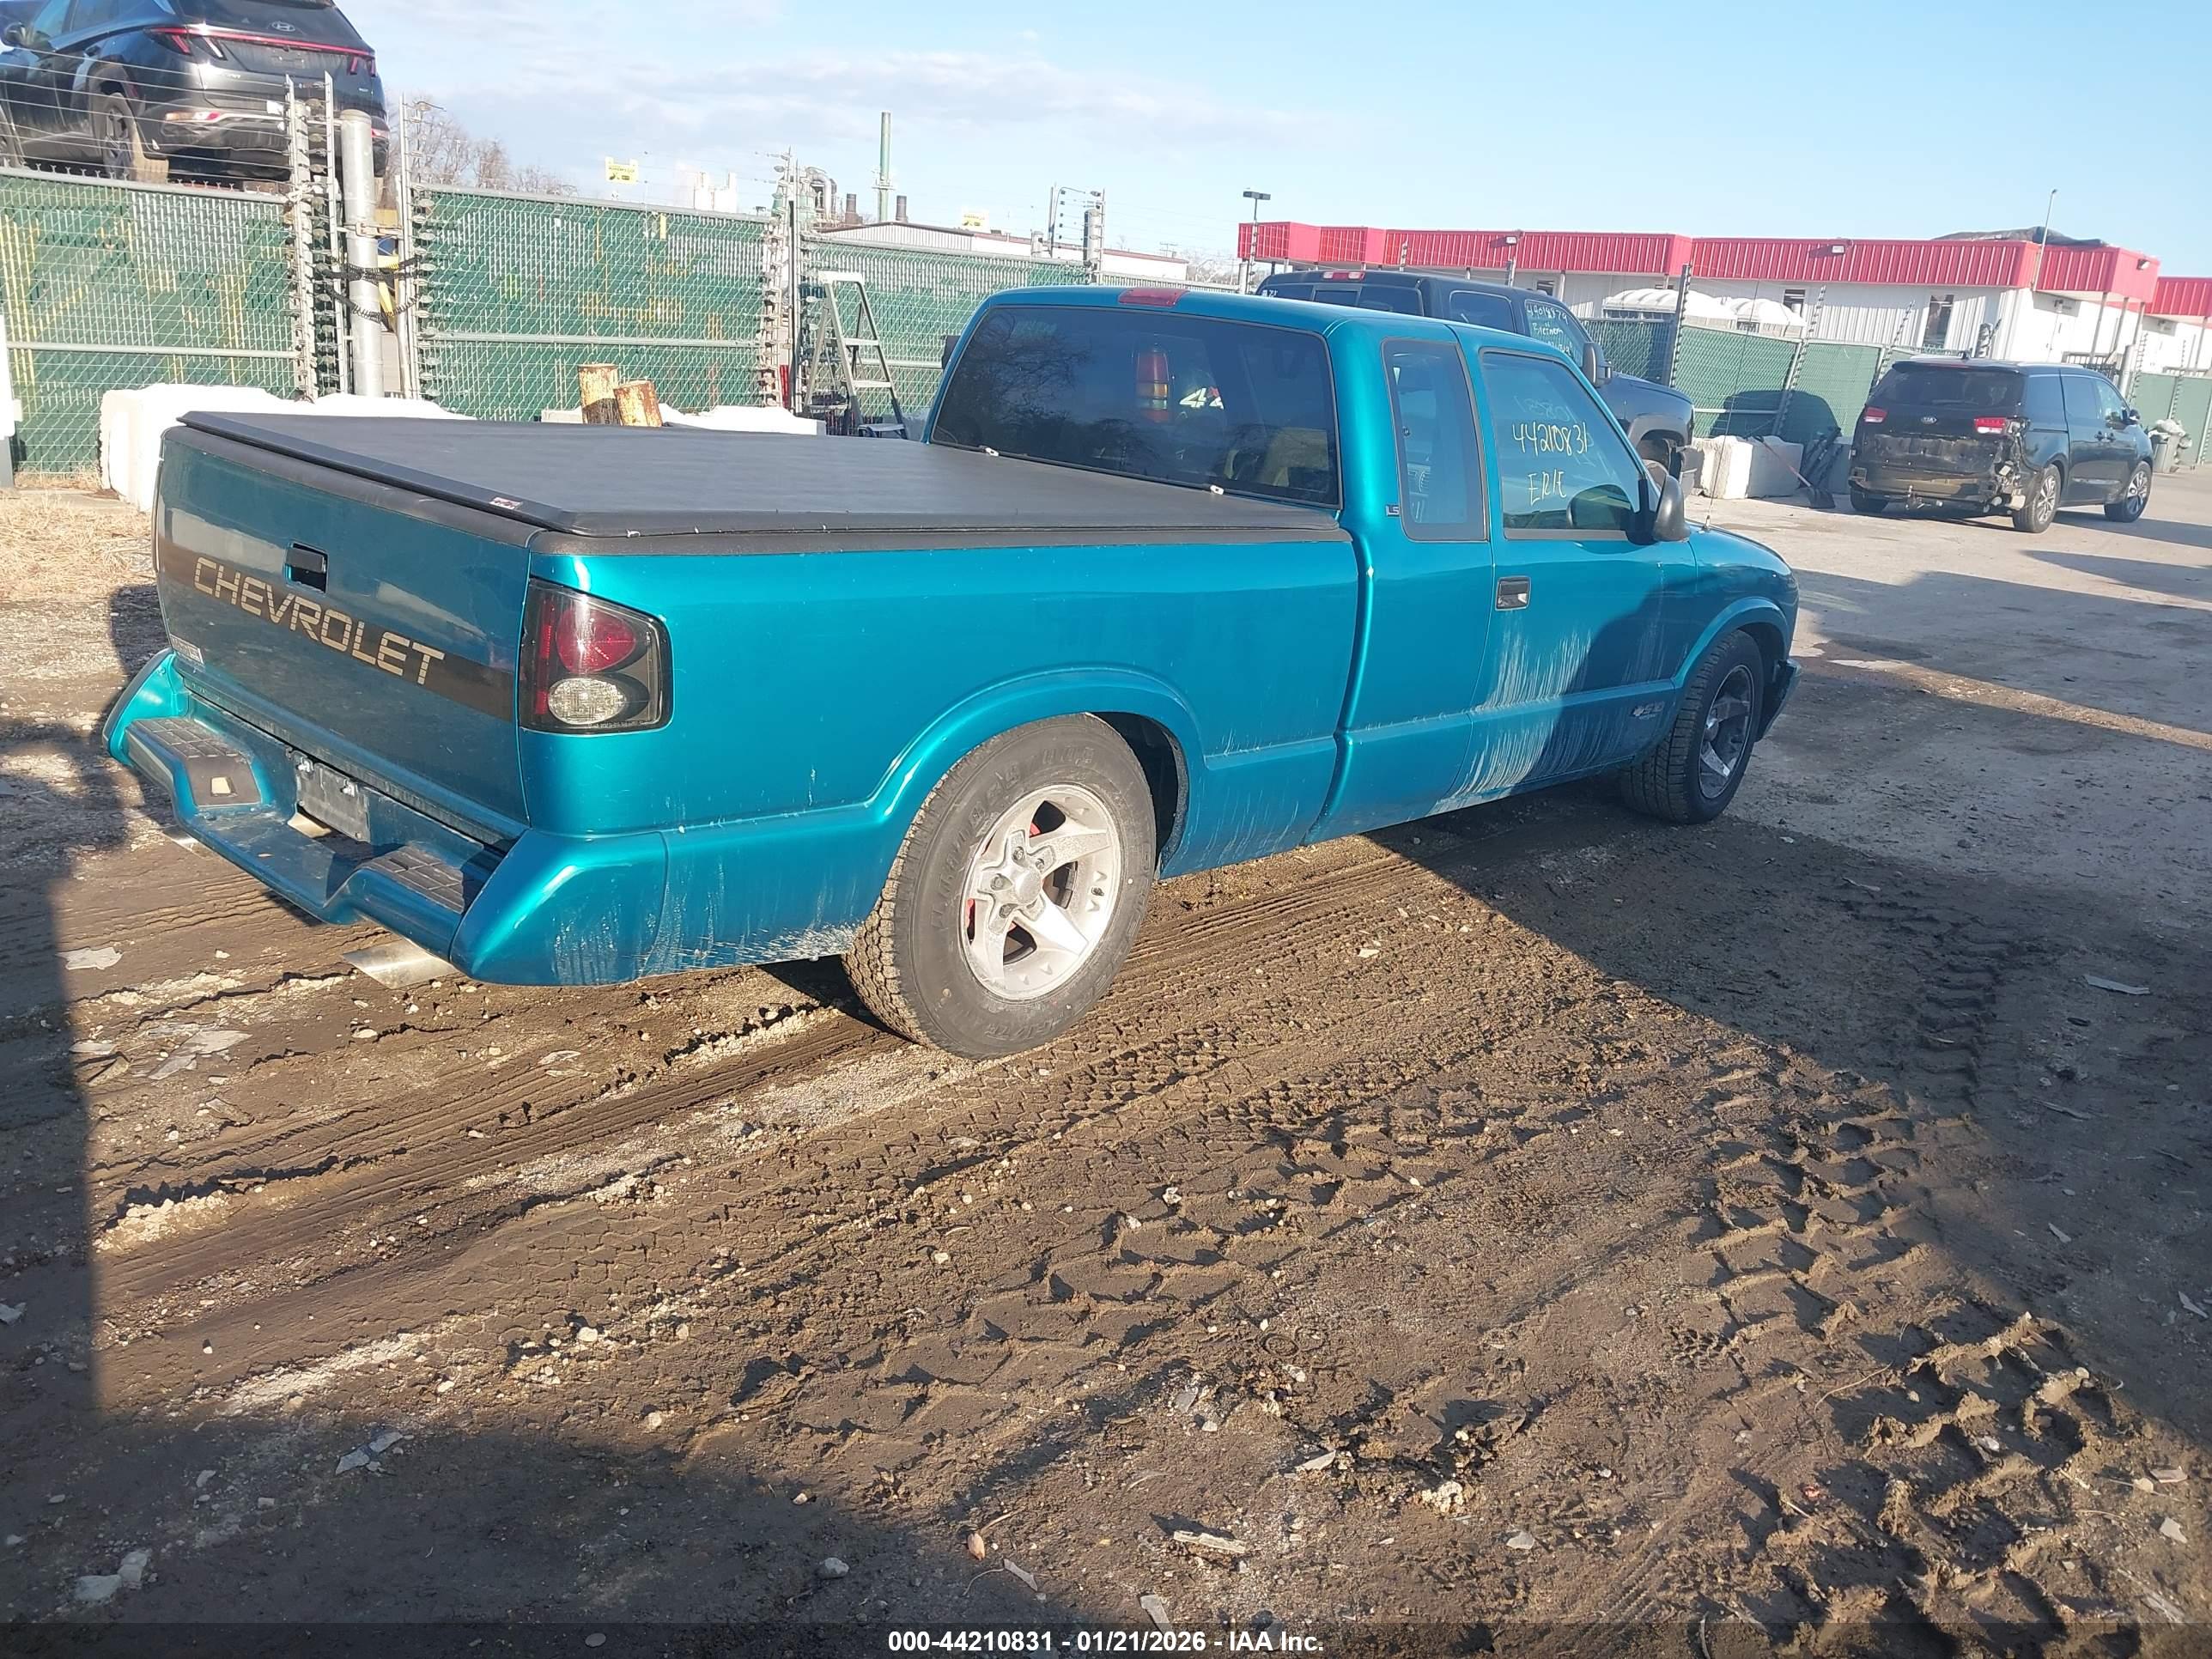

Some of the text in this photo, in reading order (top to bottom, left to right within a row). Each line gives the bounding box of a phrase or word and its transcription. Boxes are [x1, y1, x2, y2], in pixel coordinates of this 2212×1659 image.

[1512, 422, 1587, 456] 44210831
[1528, 469, 1567, 507] ERIE
[1385, 505, 1400, 515] LS
[193, 556, 446, 685] CHEVROLET
